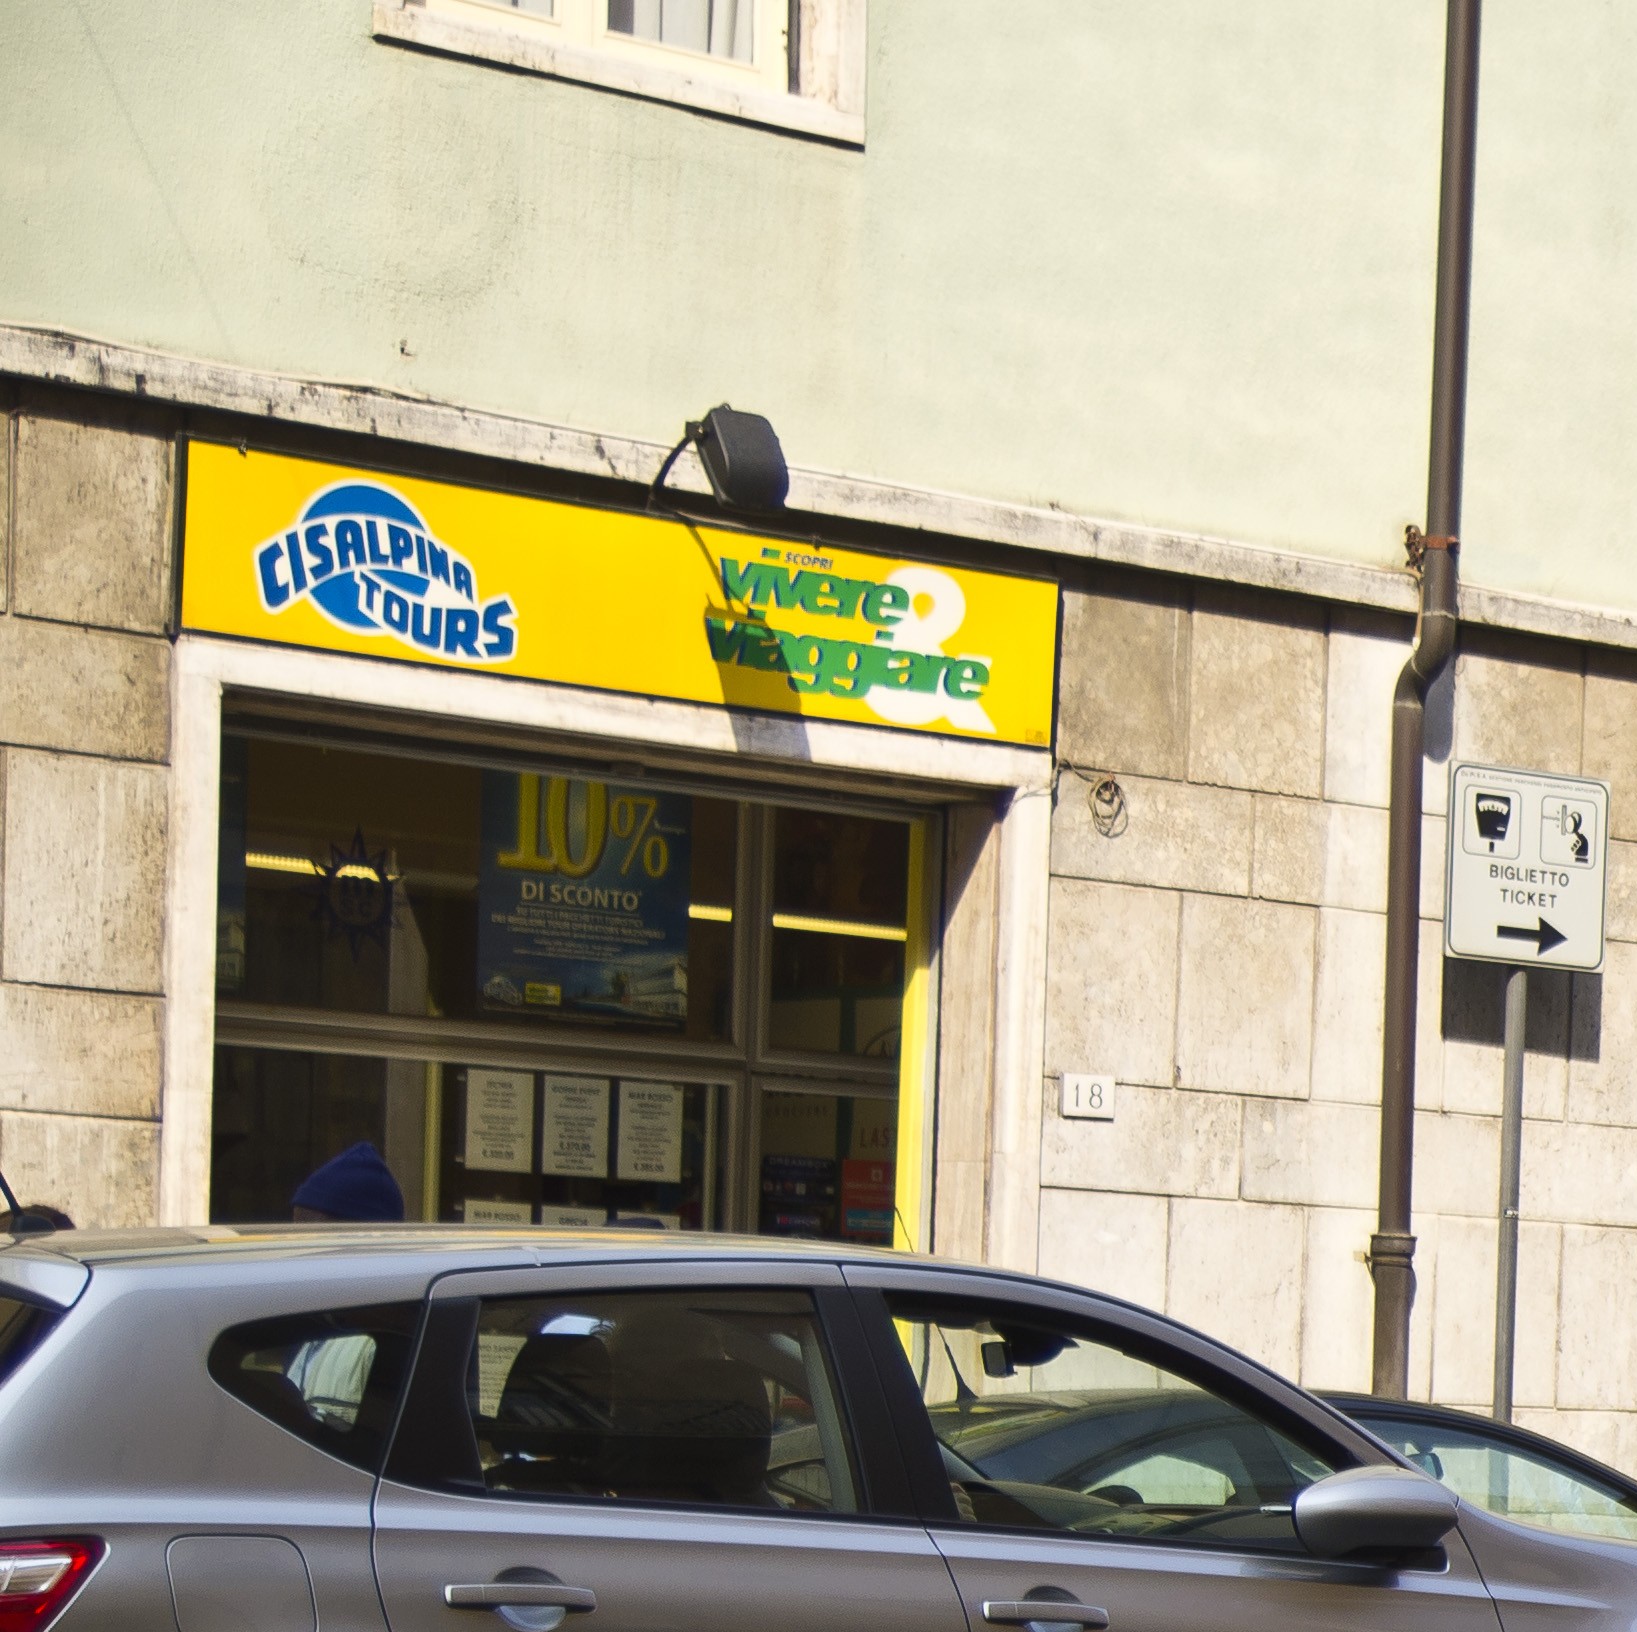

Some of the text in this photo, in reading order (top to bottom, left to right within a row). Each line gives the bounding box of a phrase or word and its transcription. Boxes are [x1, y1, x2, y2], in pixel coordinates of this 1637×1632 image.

[258, 519, 474, 609] CISALPINA
[720, 547, 910, 626] vivere
[784, 551, 834, 571] SCOPRI
[359, 569, 515, 659] TOURS
[703, 607, 990, 702] viaggiare
[495, 771, 670, 880] 10%
[1488, 864, 1571, 888] BIGLIETTO
[1500, 887, 1559, 909] TICKET
[1072, 1083, 1104, 1110] 18
